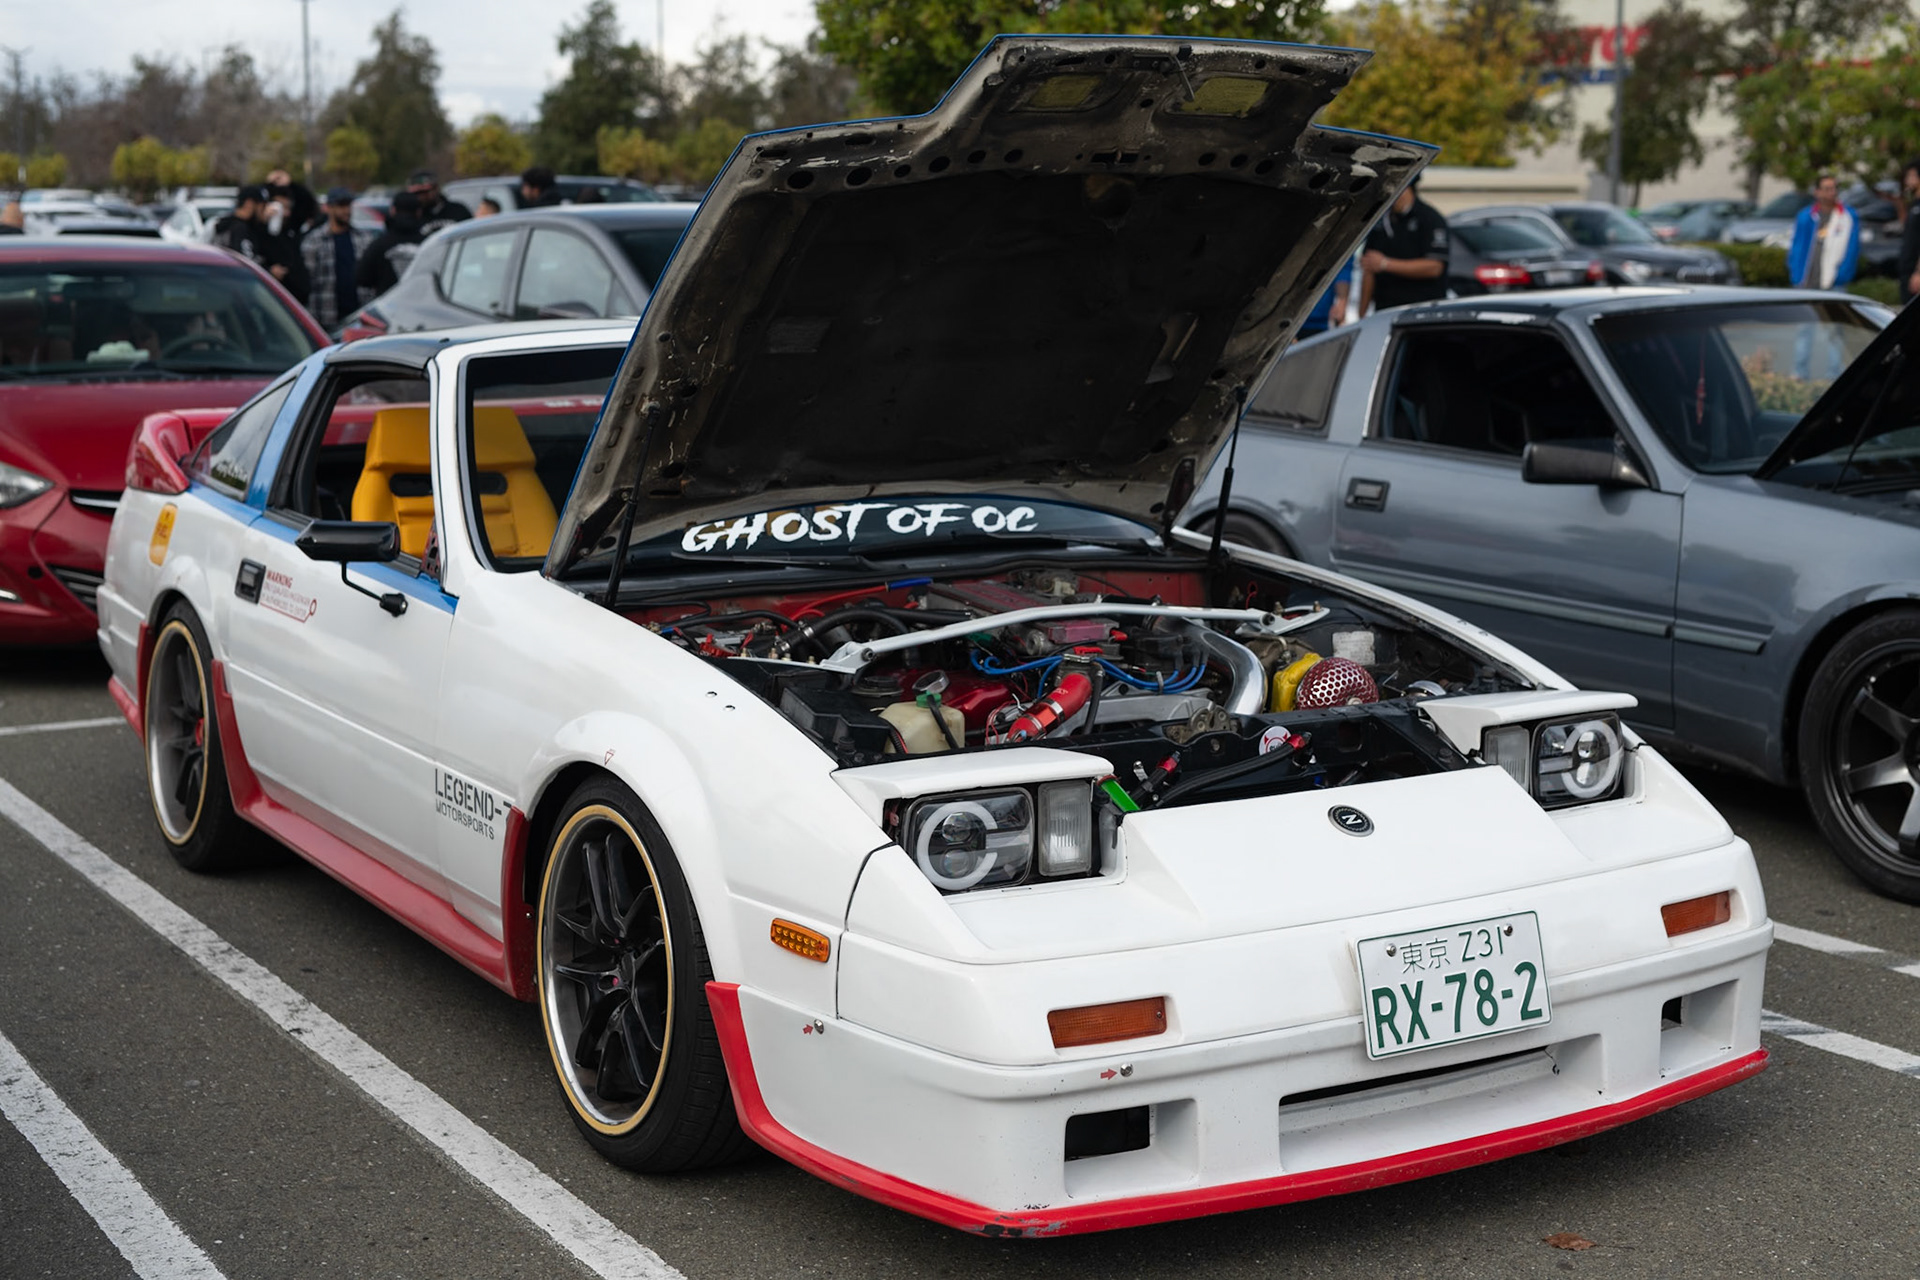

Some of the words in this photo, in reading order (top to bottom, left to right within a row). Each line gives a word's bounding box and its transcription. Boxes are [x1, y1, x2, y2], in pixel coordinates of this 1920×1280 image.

[681, 502, 898, 552] GHOST
[887, 502, 972, 536] OF
[971, 505, 1039, 532] OC
[435, 798, 495, 840] MOTORSPORTS
[1400, 937, 1451, 974] 東京
[1458, 926, 1503, 962] Z31
[1371, 961, 1543, 1049] RX-78-2
